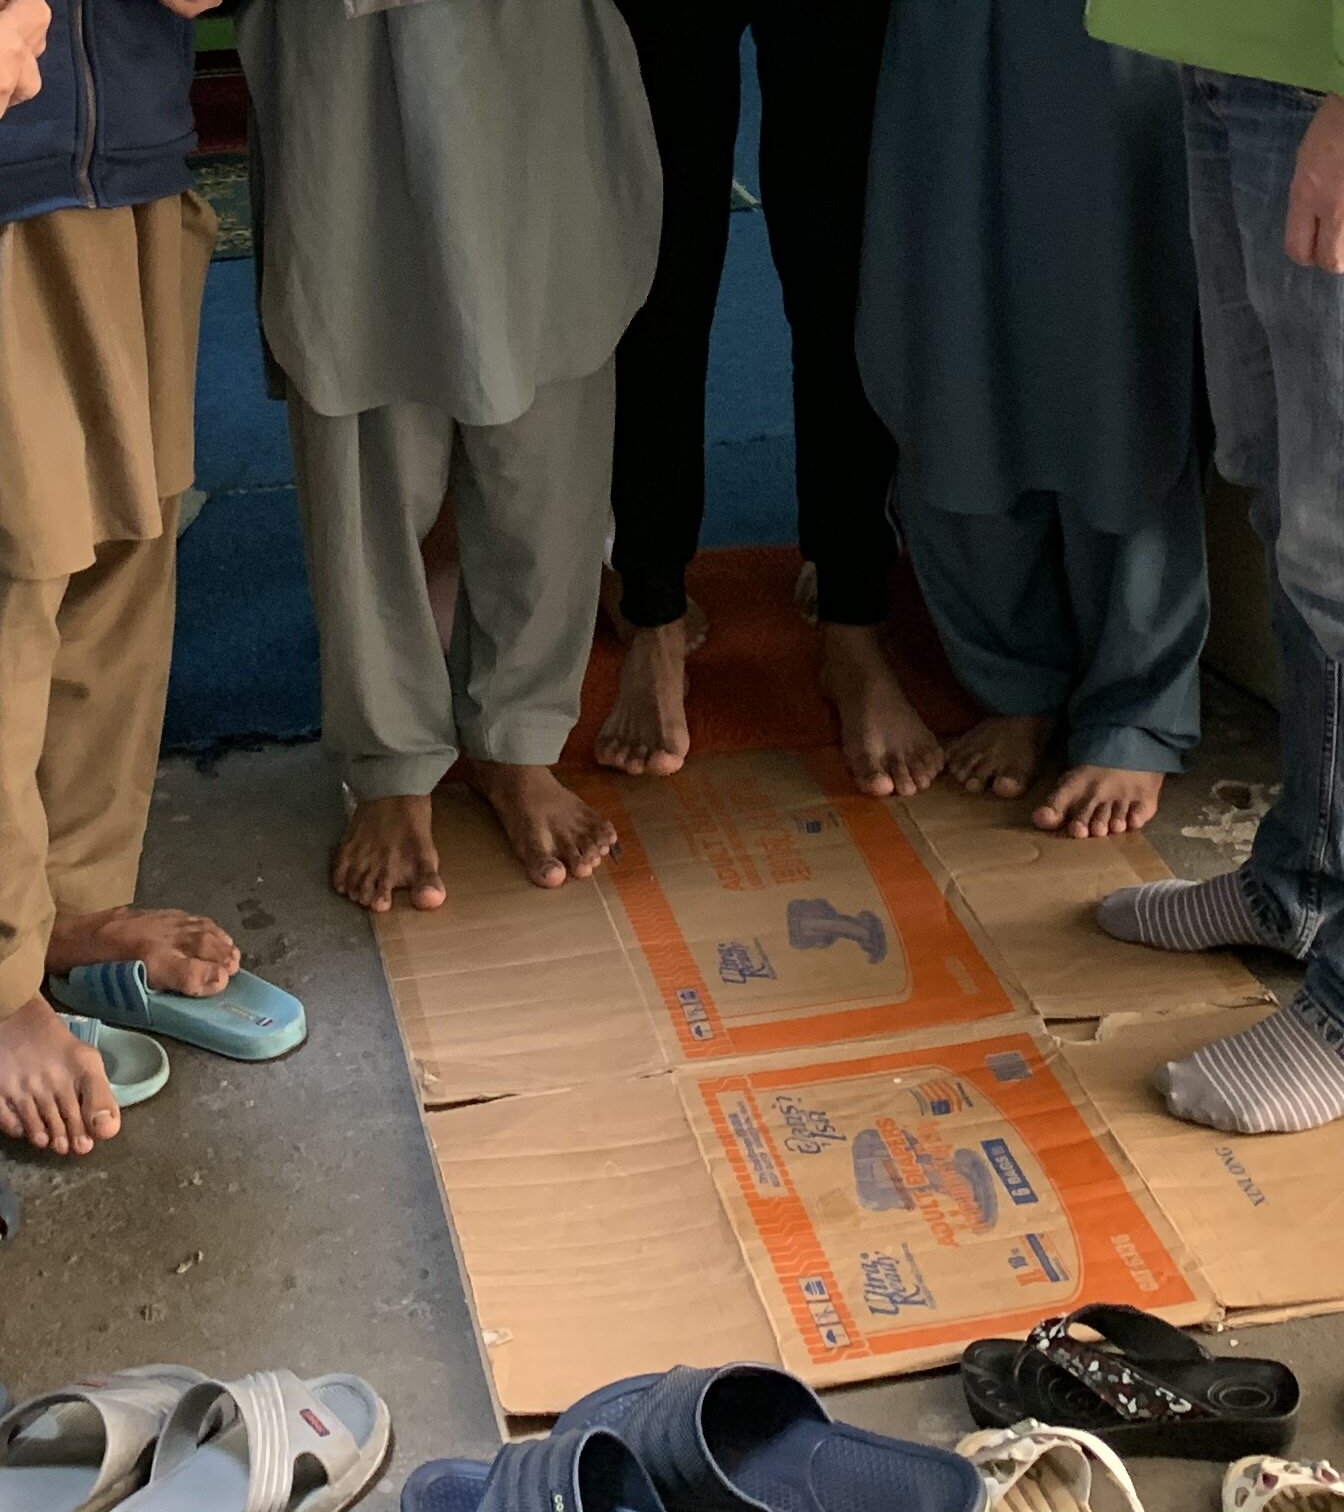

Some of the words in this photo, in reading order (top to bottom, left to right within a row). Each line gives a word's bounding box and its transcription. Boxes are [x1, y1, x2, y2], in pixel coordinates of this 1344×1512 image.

[873, 1116, 930, 1188] DIAPERS
[992, 1154, 1025, 1186] BAGS
[1009, 1185, 1033, 1199] 6
[911, 1185, 960, 1247] ADULT
